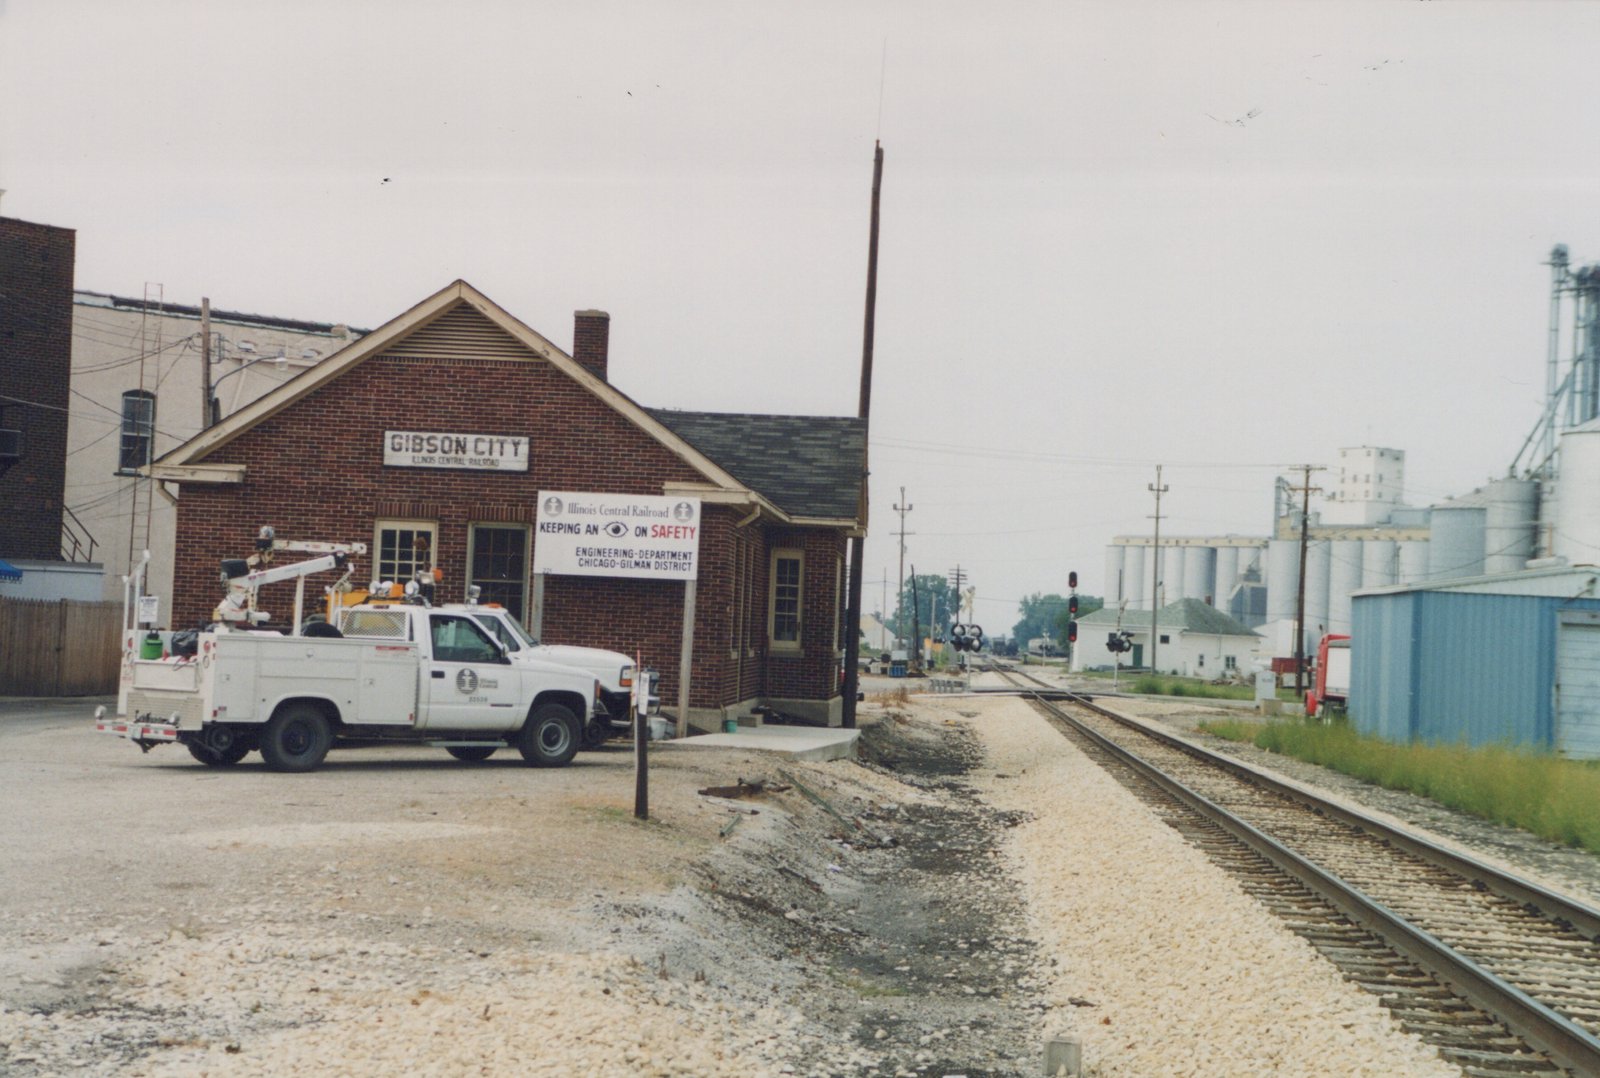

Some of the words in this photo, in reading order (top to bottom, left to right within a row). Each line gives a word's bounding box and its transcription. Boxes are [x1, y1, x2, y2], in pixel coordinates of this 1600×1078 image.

[390, 433, 467, 455] GIBSON
[473, 437, 522, 457] CITY
[568, 502, 597, 516] Illinois
[600, 503, 630, 517] Central
[632, 505, 669, 519] Railroad
[540, 521, 581, 535] KEEPING
[585, 524, 599, 535] AN
[634, 526, 648, 537] ON
[651, 524, 697, 539] SAFETY
[578, 557, 652, 570] CHICAGO-GILMAN
[654, 560, 692, 572] DISTRICT
